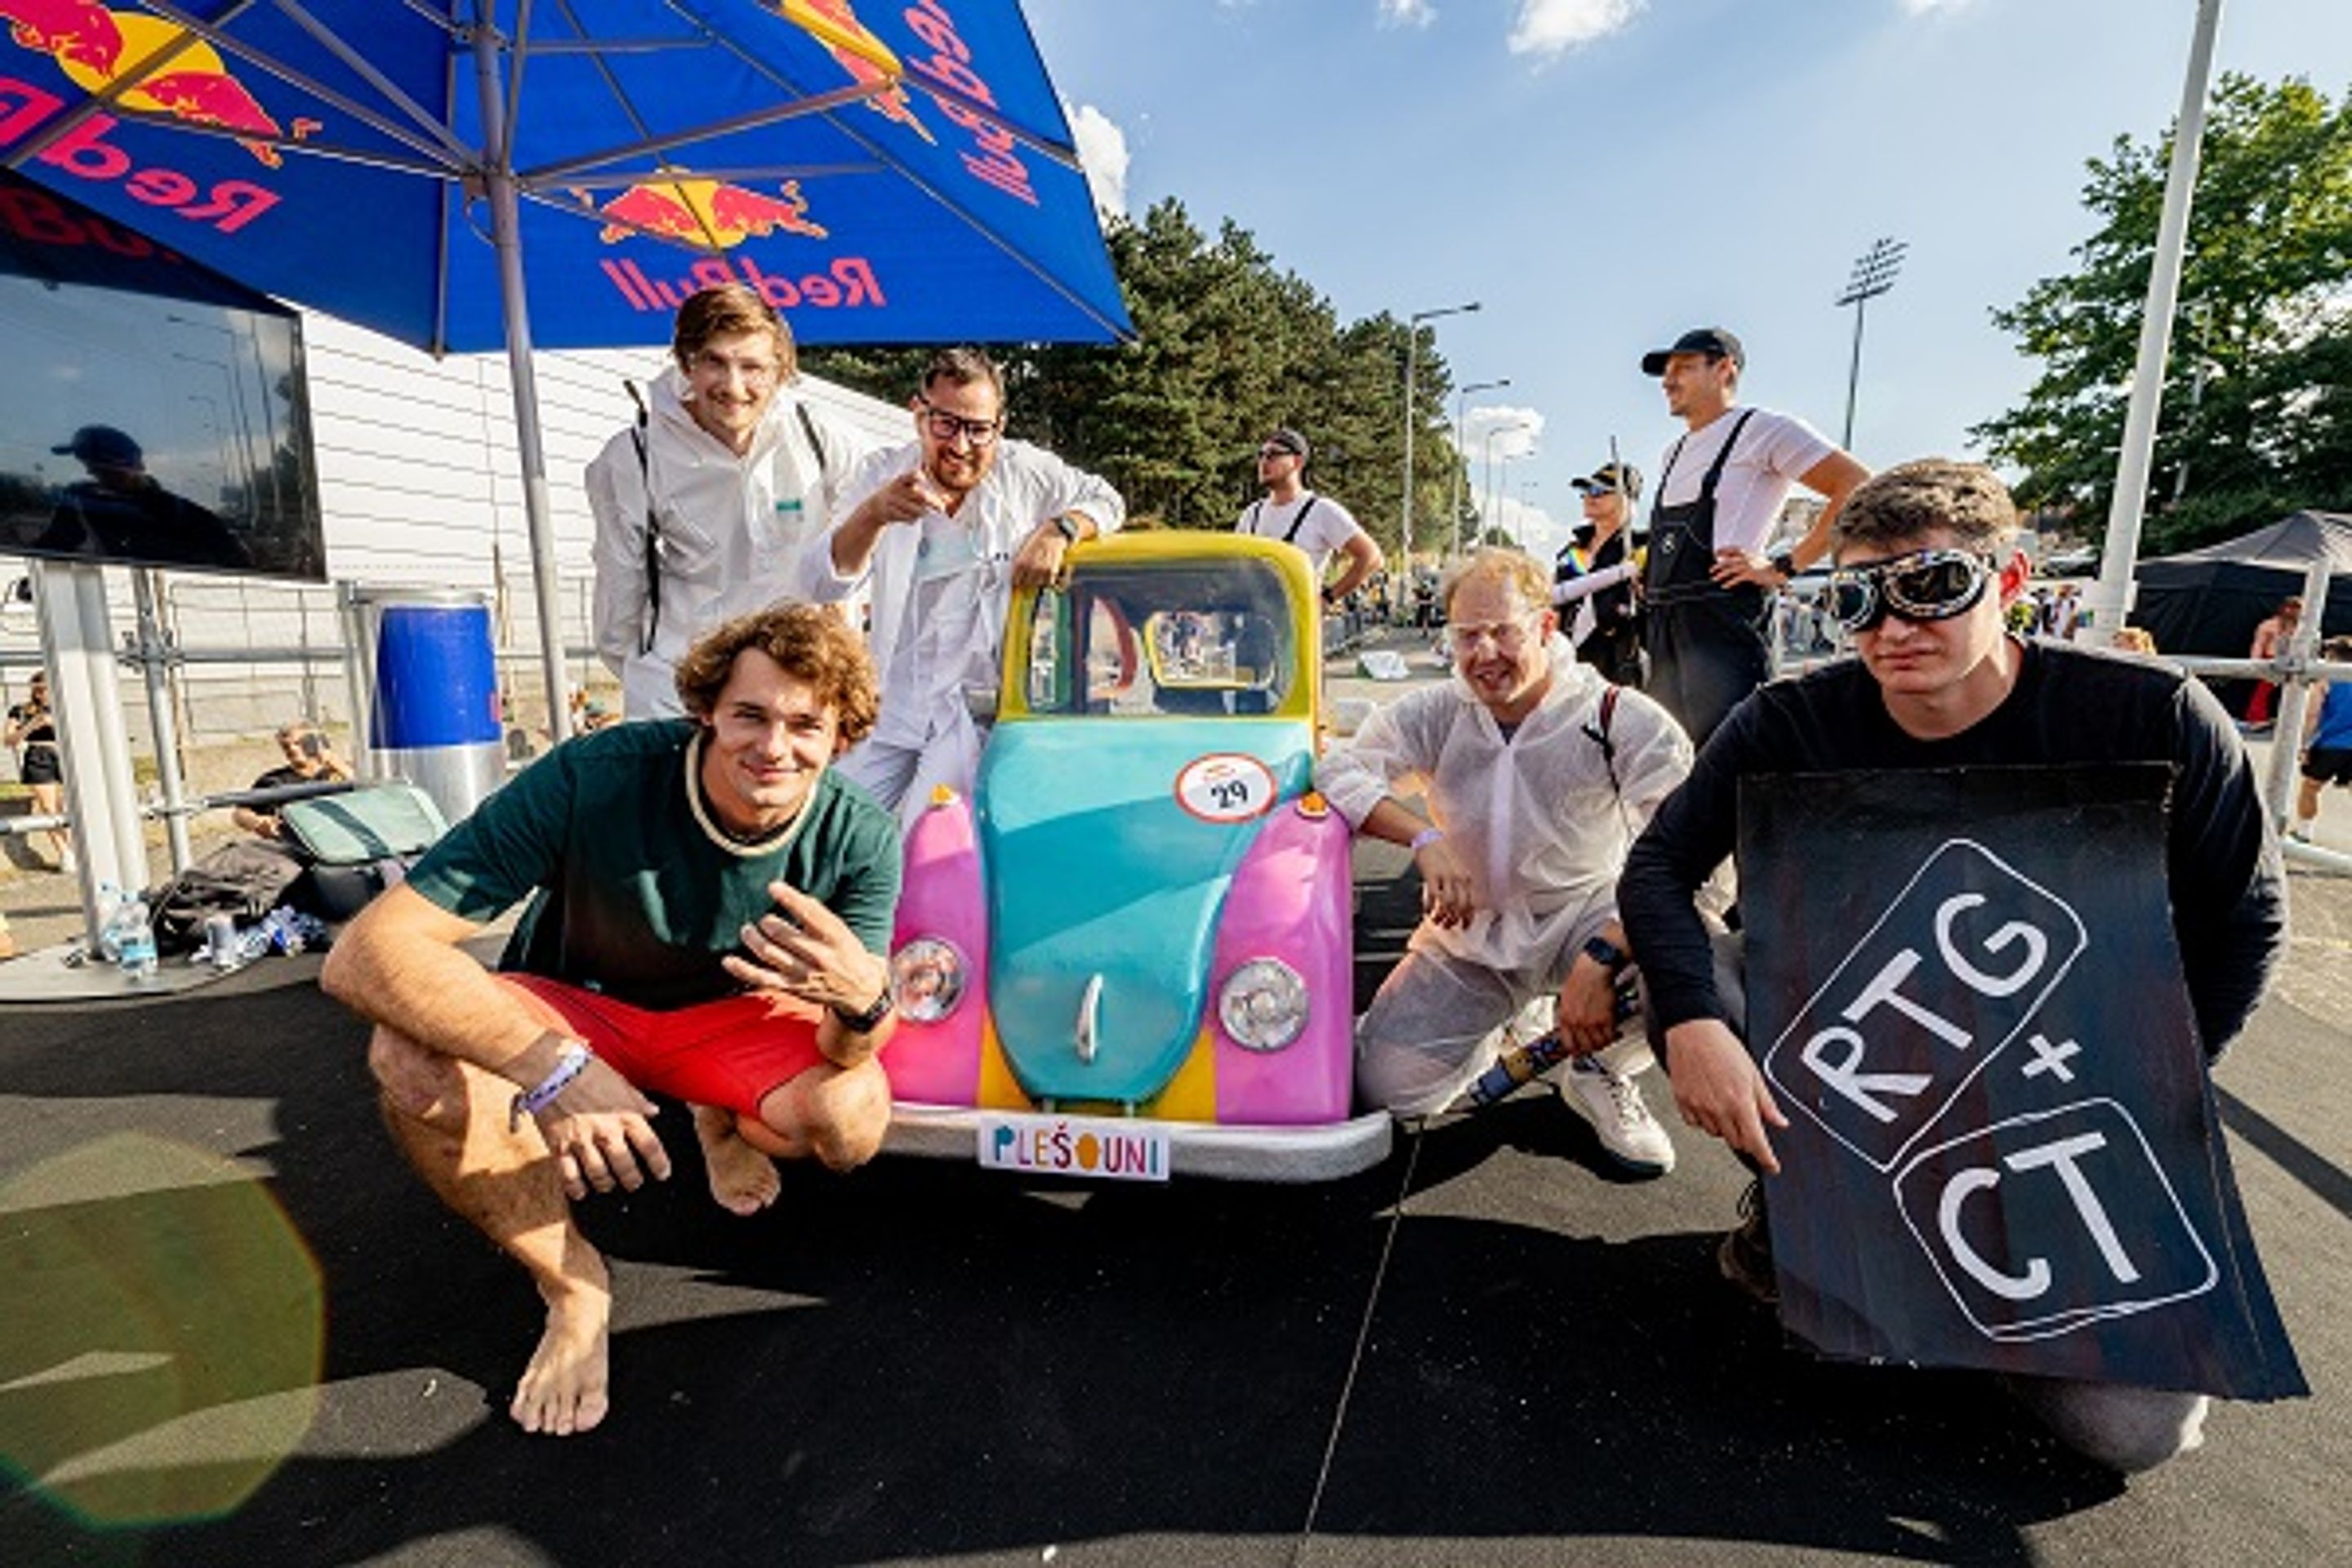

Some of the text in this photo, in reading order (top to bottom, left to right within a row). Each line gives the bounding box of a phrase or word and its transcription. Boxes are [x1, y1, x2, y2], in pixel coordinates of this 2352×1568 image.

[1211, 780, 1248, 808] 29
[1801, 893, 2048, 1124] RTG
[994, 1121, 1158, 1176] PLEŠOUNI
[1939, 1132, 2141, 1299] CT
